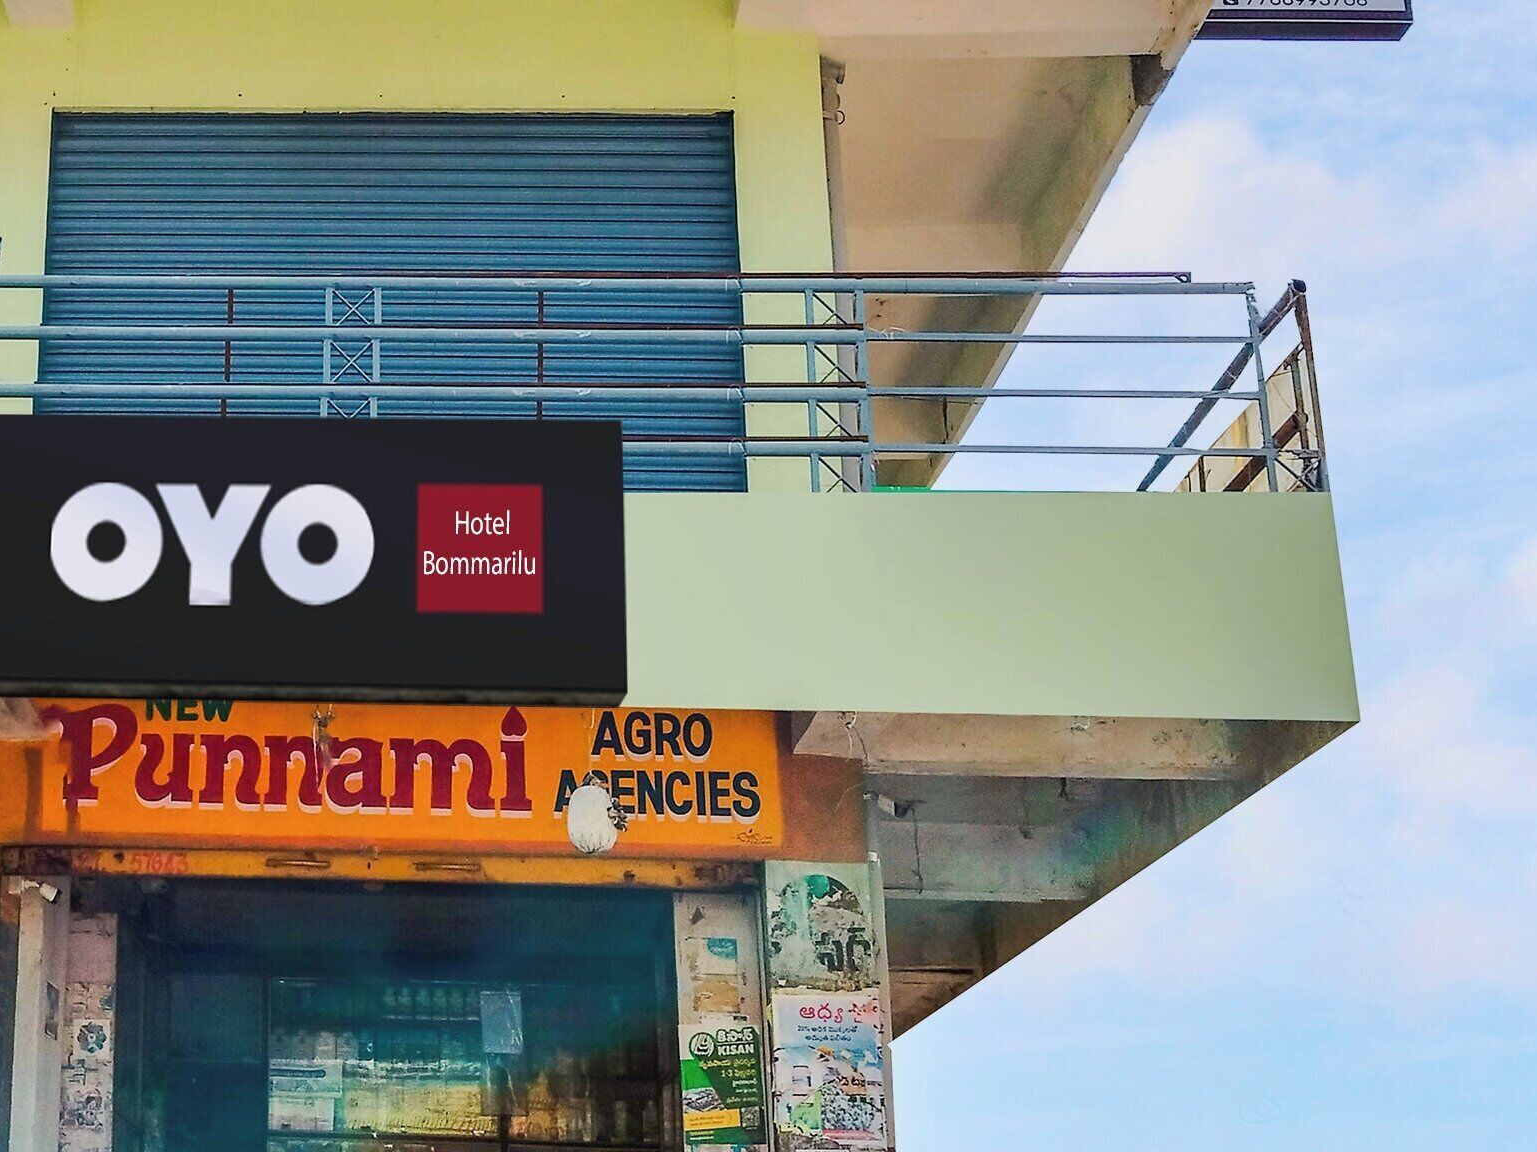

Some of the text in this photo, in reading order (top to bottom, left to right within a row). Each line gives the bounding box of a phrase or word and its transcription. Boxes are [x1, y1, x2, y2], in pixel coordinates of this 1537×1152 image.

[453, 510, 512, 536] Hotel
[50, 481, 375, 606] OYO
[422, 549, 538, 577] Bommarilu
[144, 699, 234, 722] NEW
[590, 710, 713, 759] AGRO
[53, 704, 533, 814] Punnami
[718, 1044, 754, 1056] KISAN
